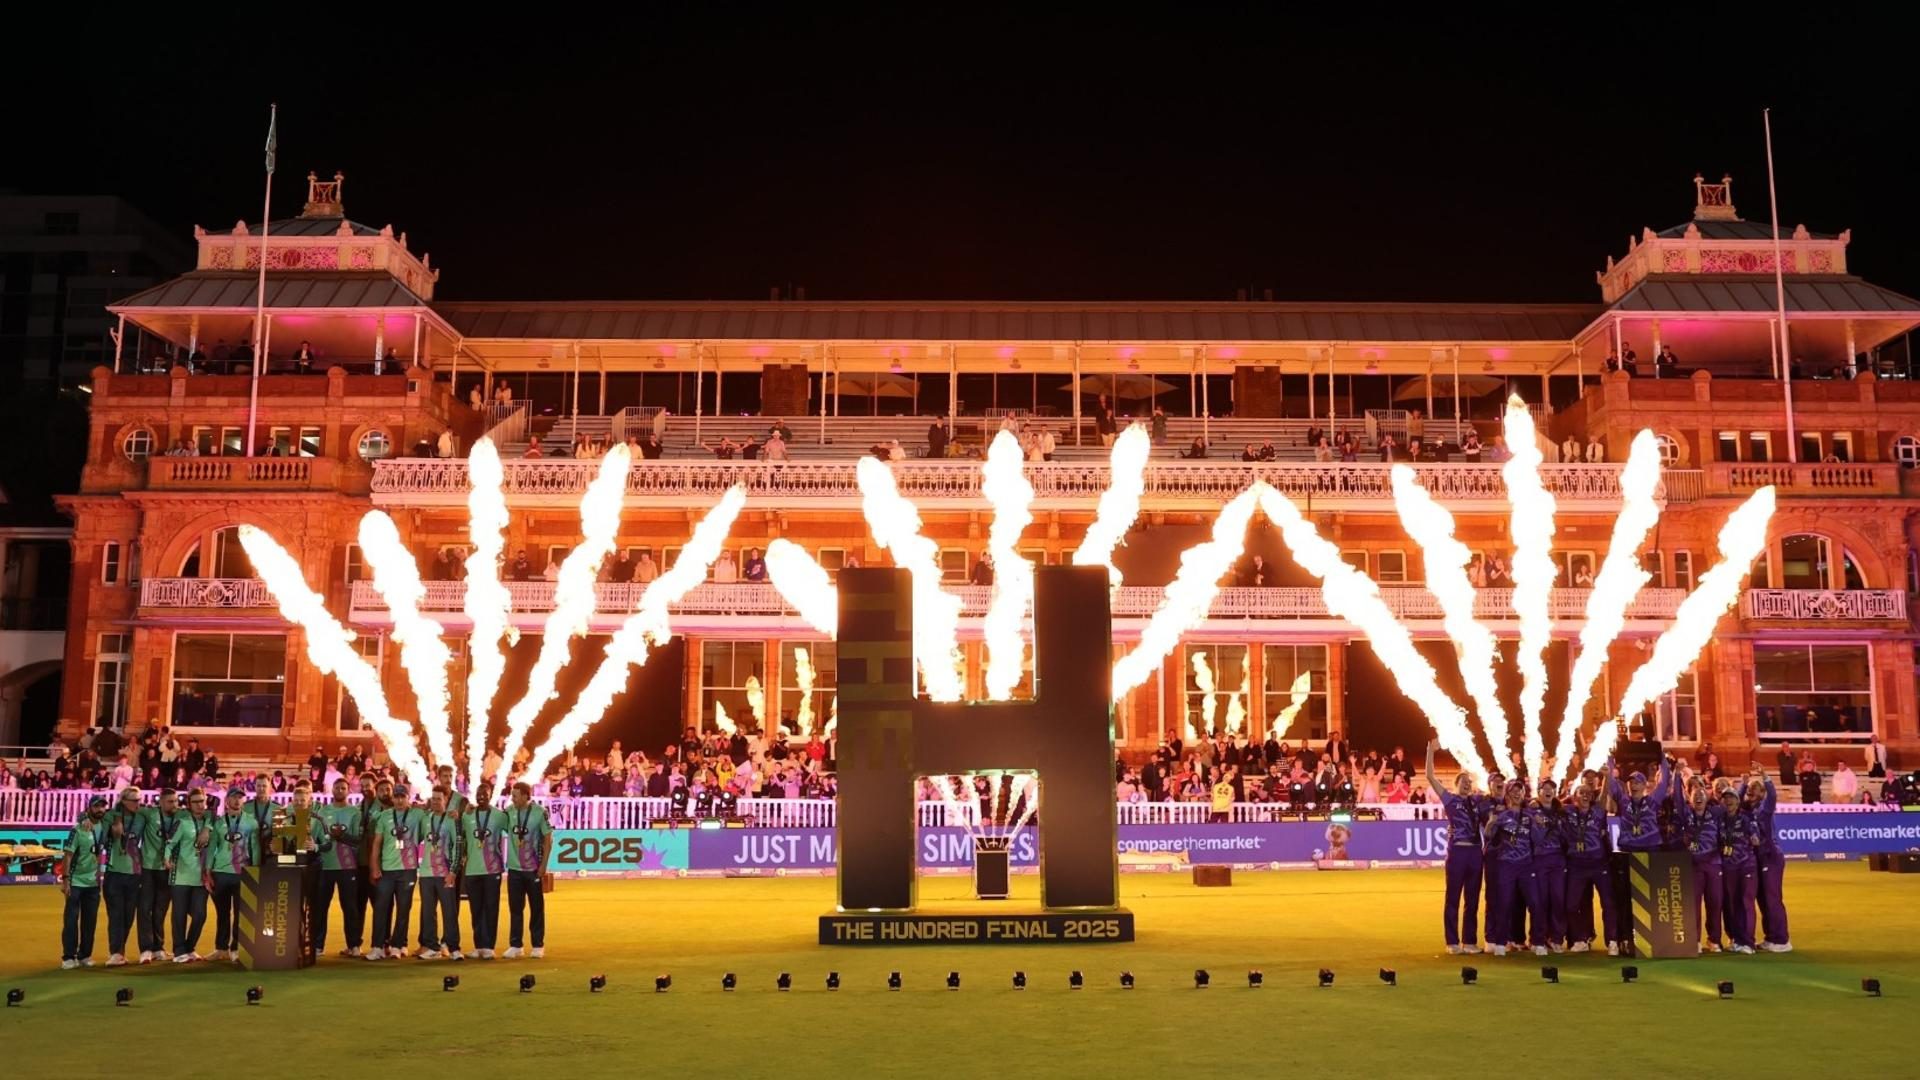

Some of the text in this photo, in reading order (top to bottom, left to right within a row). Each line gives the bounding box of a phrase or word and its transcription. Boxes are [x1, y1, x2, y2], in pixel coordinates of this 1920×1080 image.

[1117, 836, 1262, 853] comparethemarket
[1397, 827, 1448, 857] JUS
[1779, 825, 1920, 842] comparethemarket
[558, 838, 643, 864] 2025
[733, 834, 801, 864] JUST
[275, 881, 288, 957] CHAMPIONS
[1657, 887, 1669, 923] 2025
[1669, 866, 1685, 944] CHAMPIONS
[832, 920, 1121, 940] THE HUNDRED FINAL 2025
